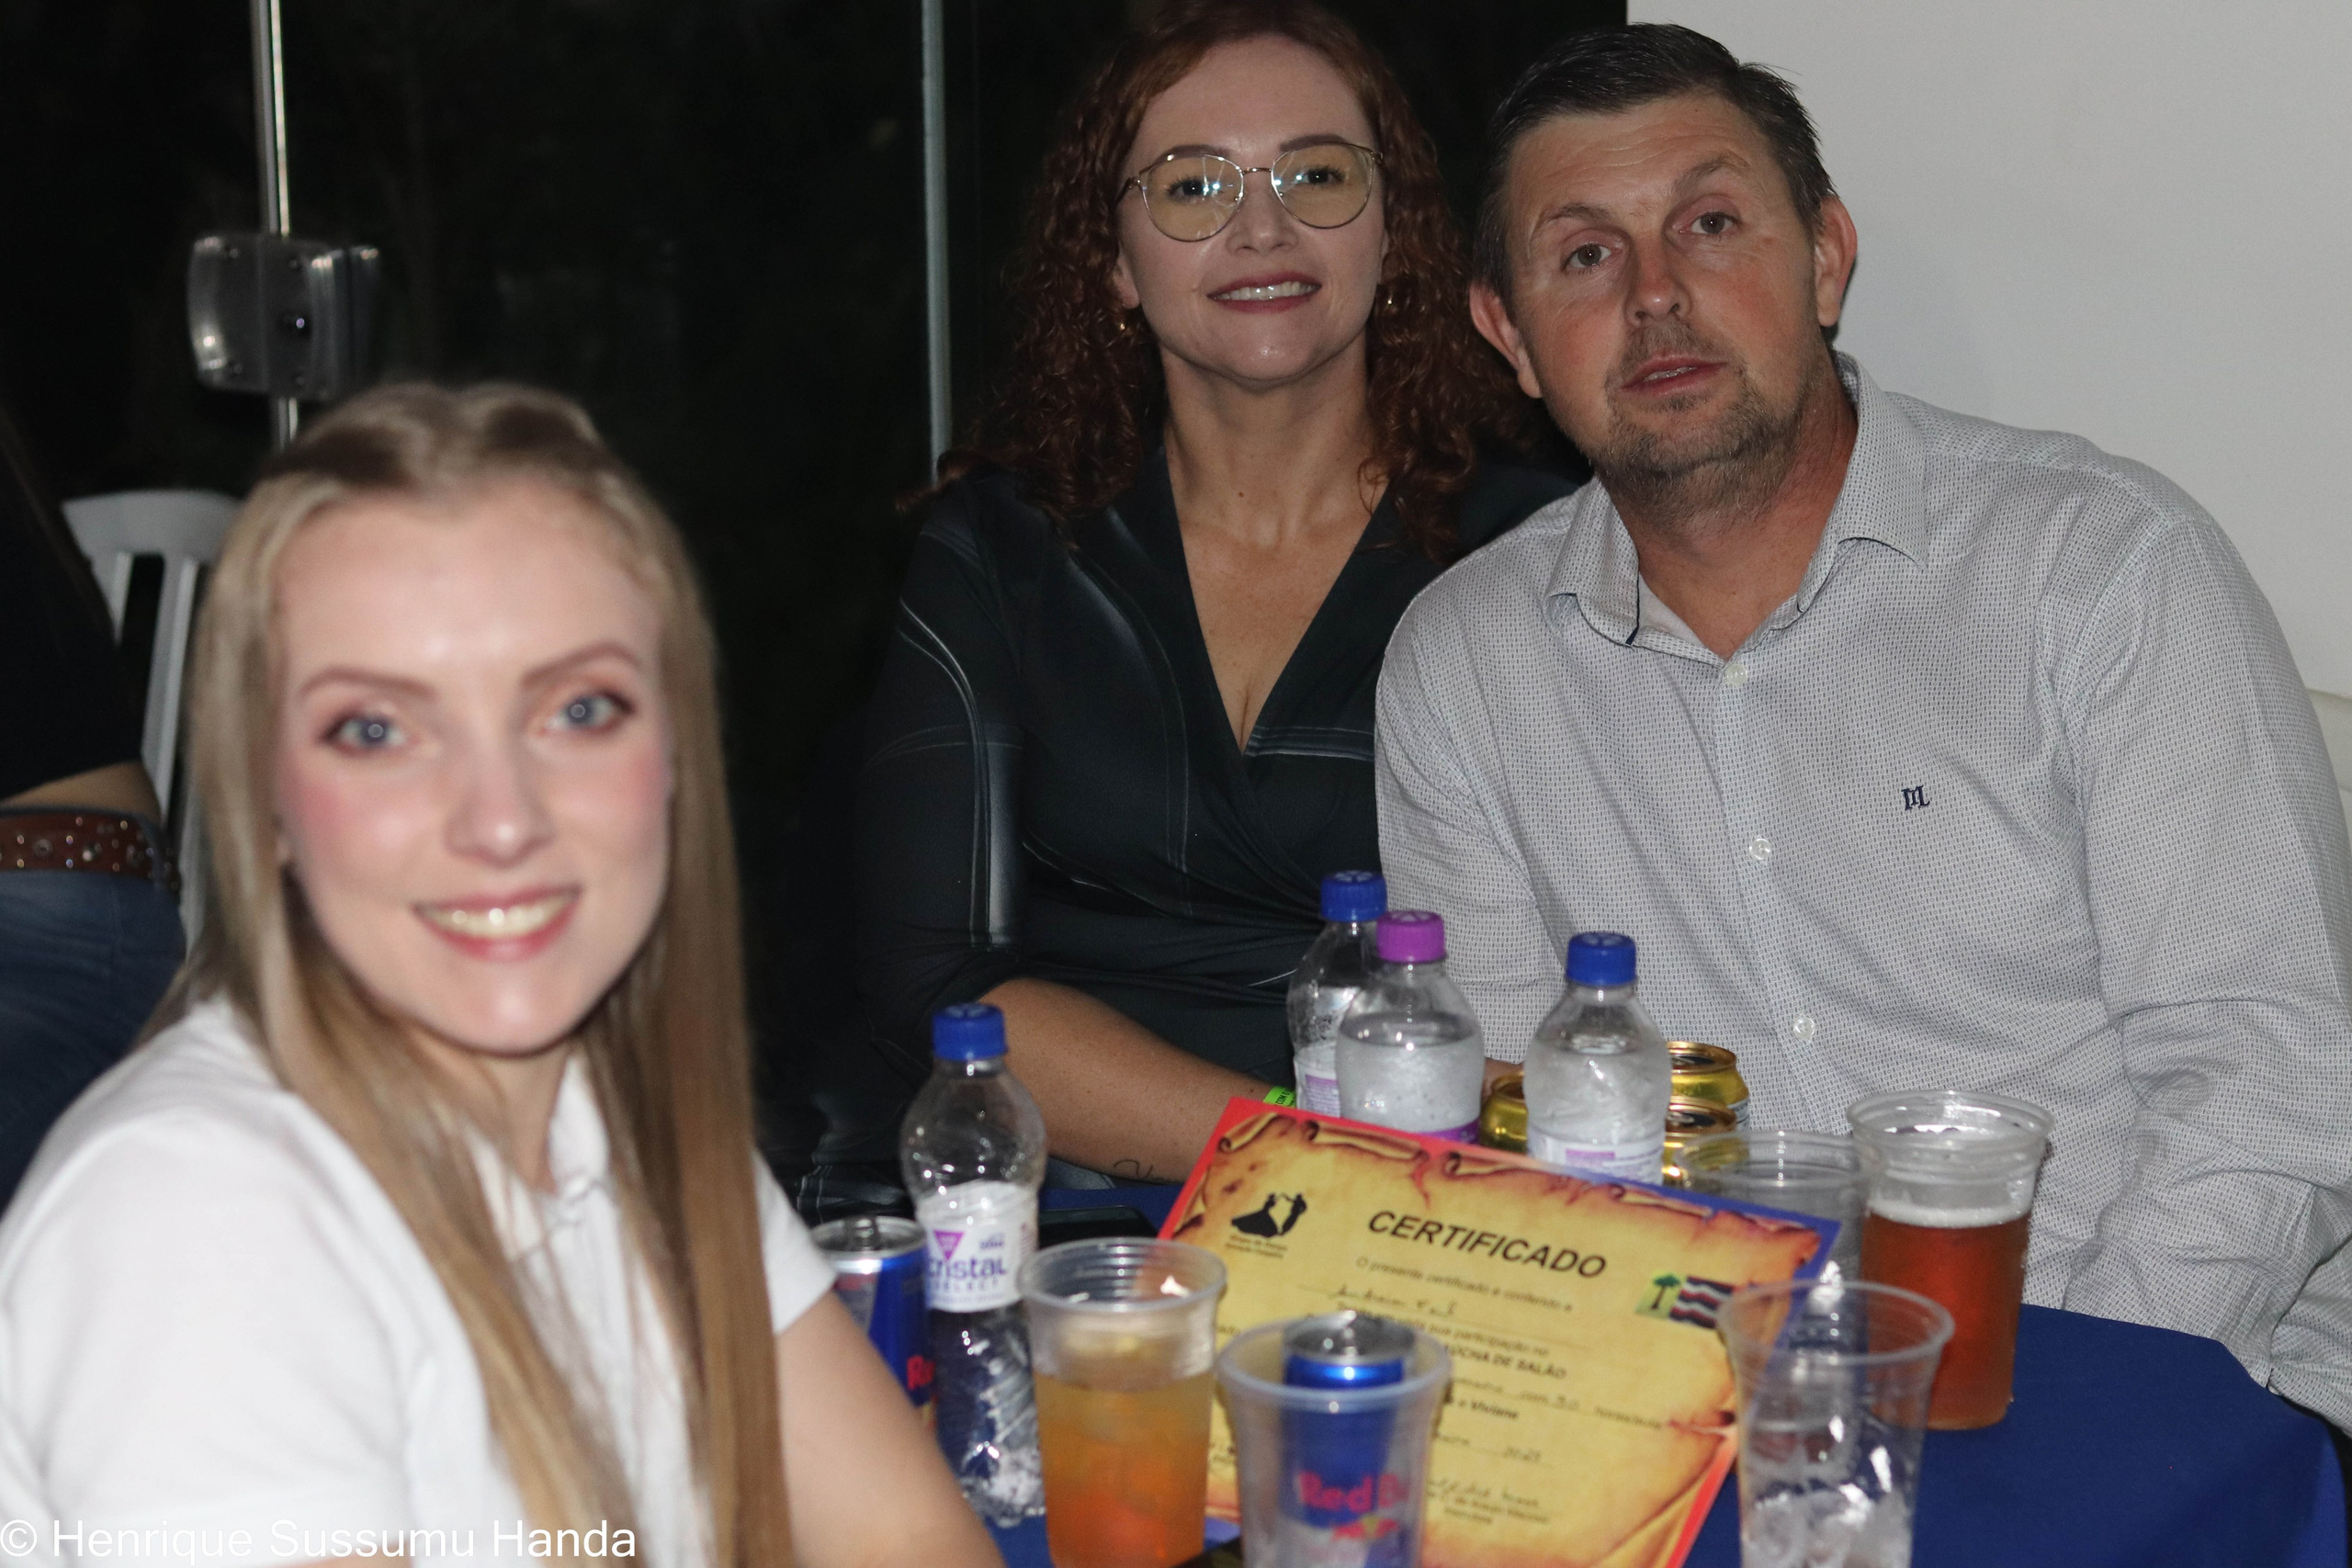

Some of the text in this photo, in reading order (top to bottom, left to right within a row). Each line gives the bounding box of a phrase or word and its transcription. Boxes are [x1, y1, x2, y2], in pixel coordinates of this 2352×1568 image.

[1367, 1210, 1608, 1279] CERTIFICADO
[1426, 1272, 1490, 1295] certificado
[1299, 1470, 1374, 1513] Red
